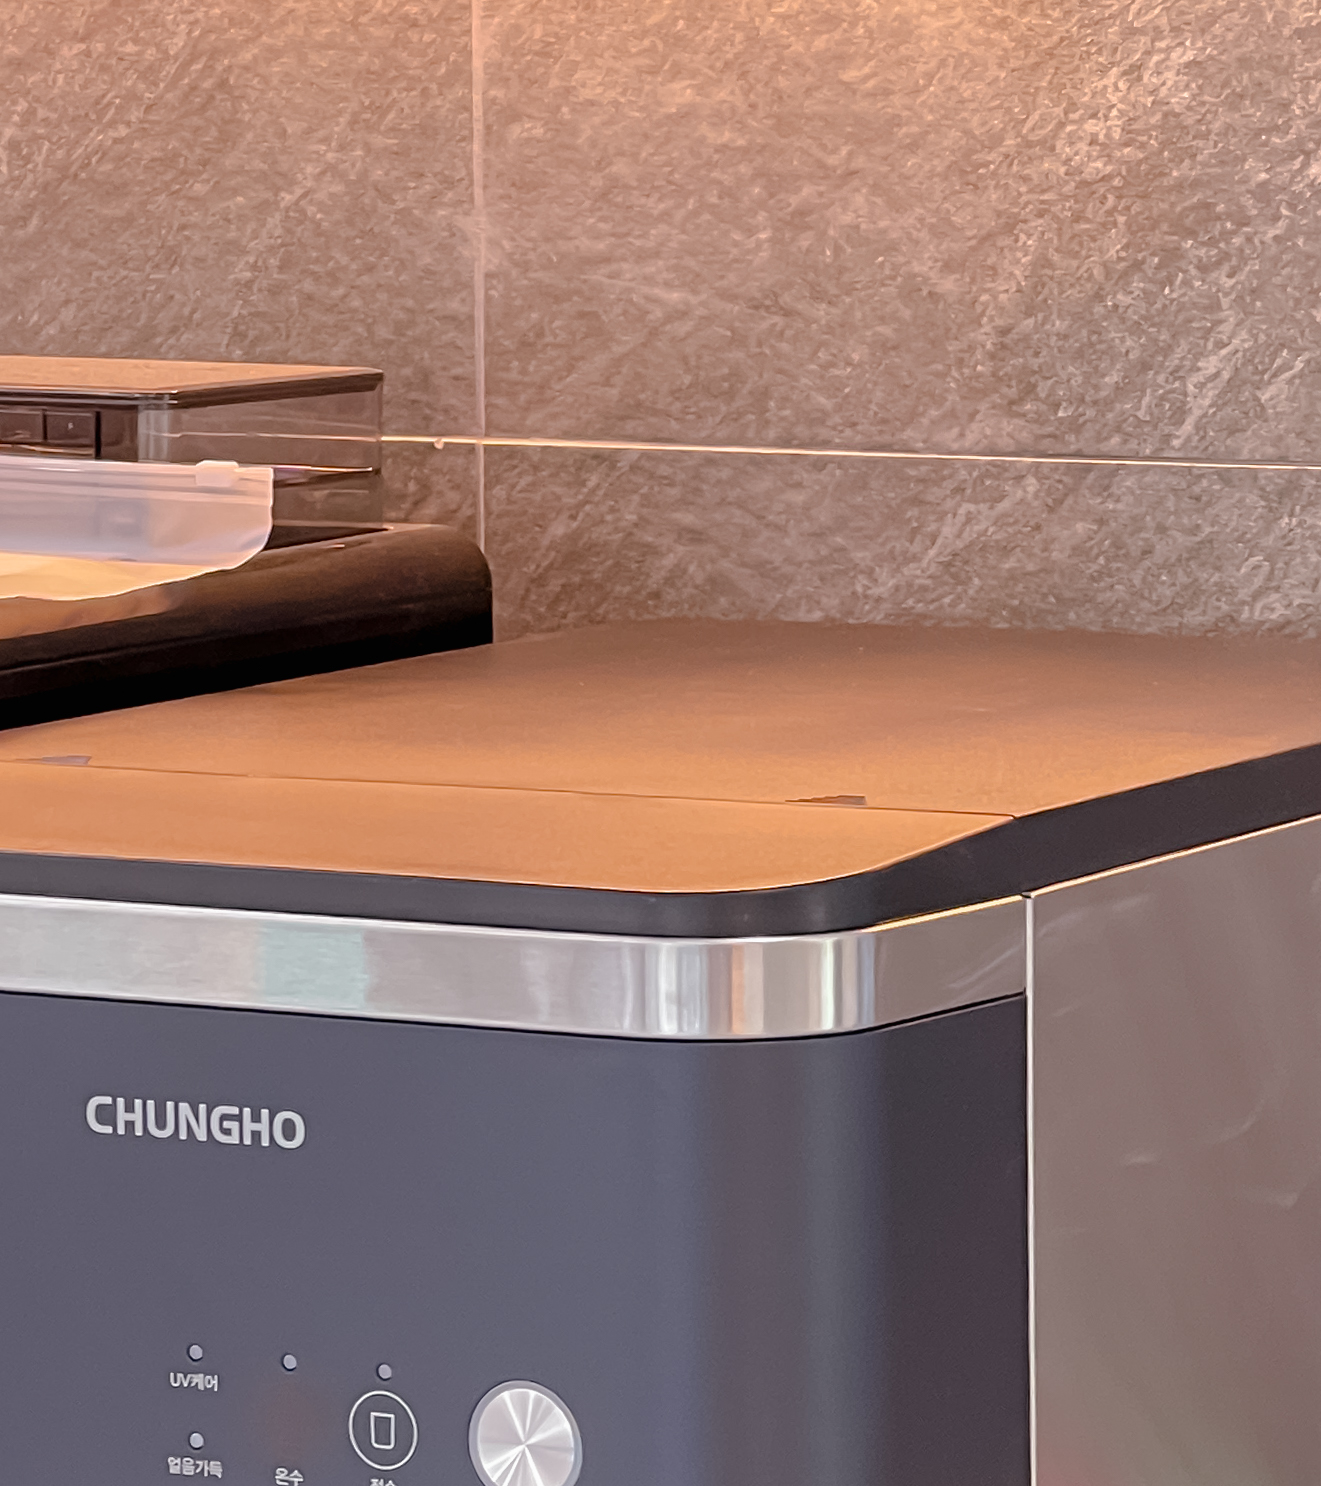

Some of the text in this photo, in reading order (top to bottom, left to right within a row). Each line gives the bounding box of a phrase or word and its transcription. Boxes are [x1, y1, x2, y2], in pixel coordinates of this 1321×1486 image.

[85, 1095, 306, 1149] CHUNGHO
[169, 1372, 219, 1391] UV케어
[167, 1456, 223, 1479] 얼음가득
[274, 1467, 305, 1486] 온수
